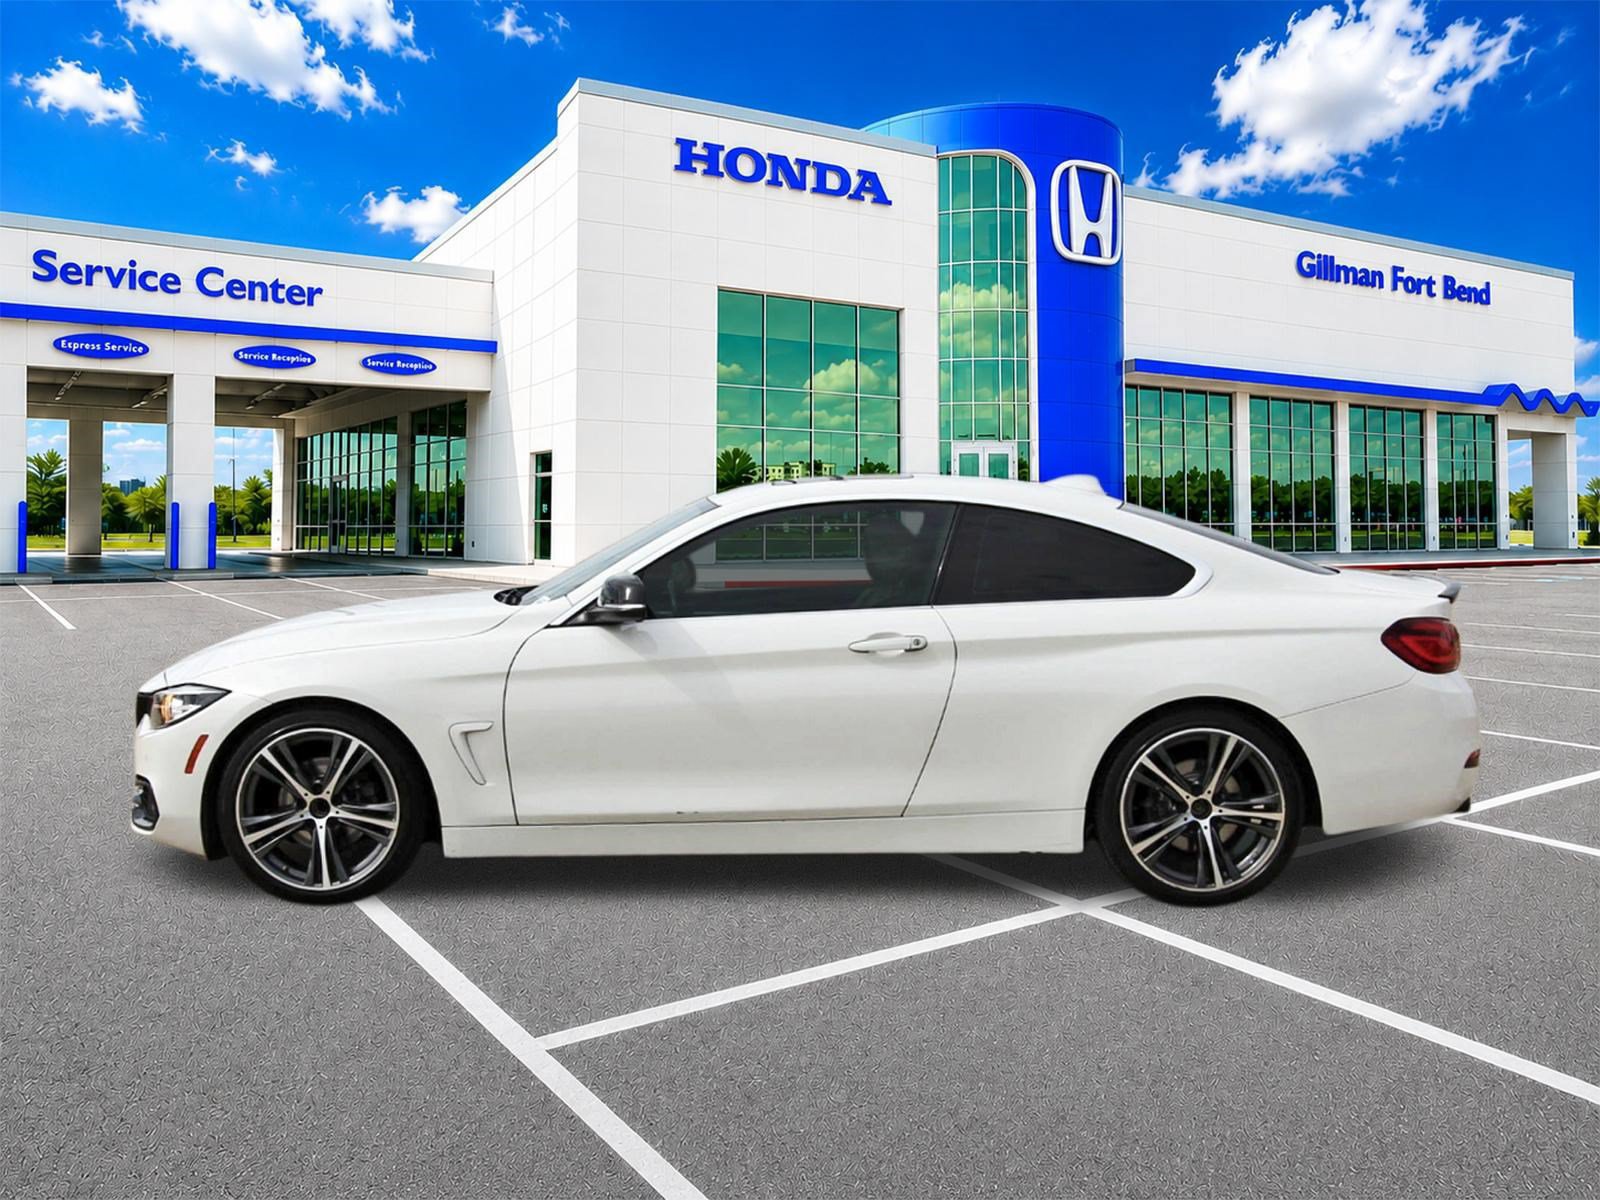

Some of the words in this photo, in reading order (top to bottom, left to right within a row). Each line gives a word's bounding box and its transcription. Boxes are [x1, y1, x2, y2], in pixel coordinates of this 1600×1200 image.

[674, 137, 892, 206] HONDA
[32, 249, 182, 295] Service
[195, 267, 324, 307] Center
[1296, 250, 1384, 289] Gillman
[1391, 265, 1436, 298] Fort
[1442, 275, 1491, 305] Bend
[104, 342, 144, 354] Service
[238, 351, 269, 361] Service
